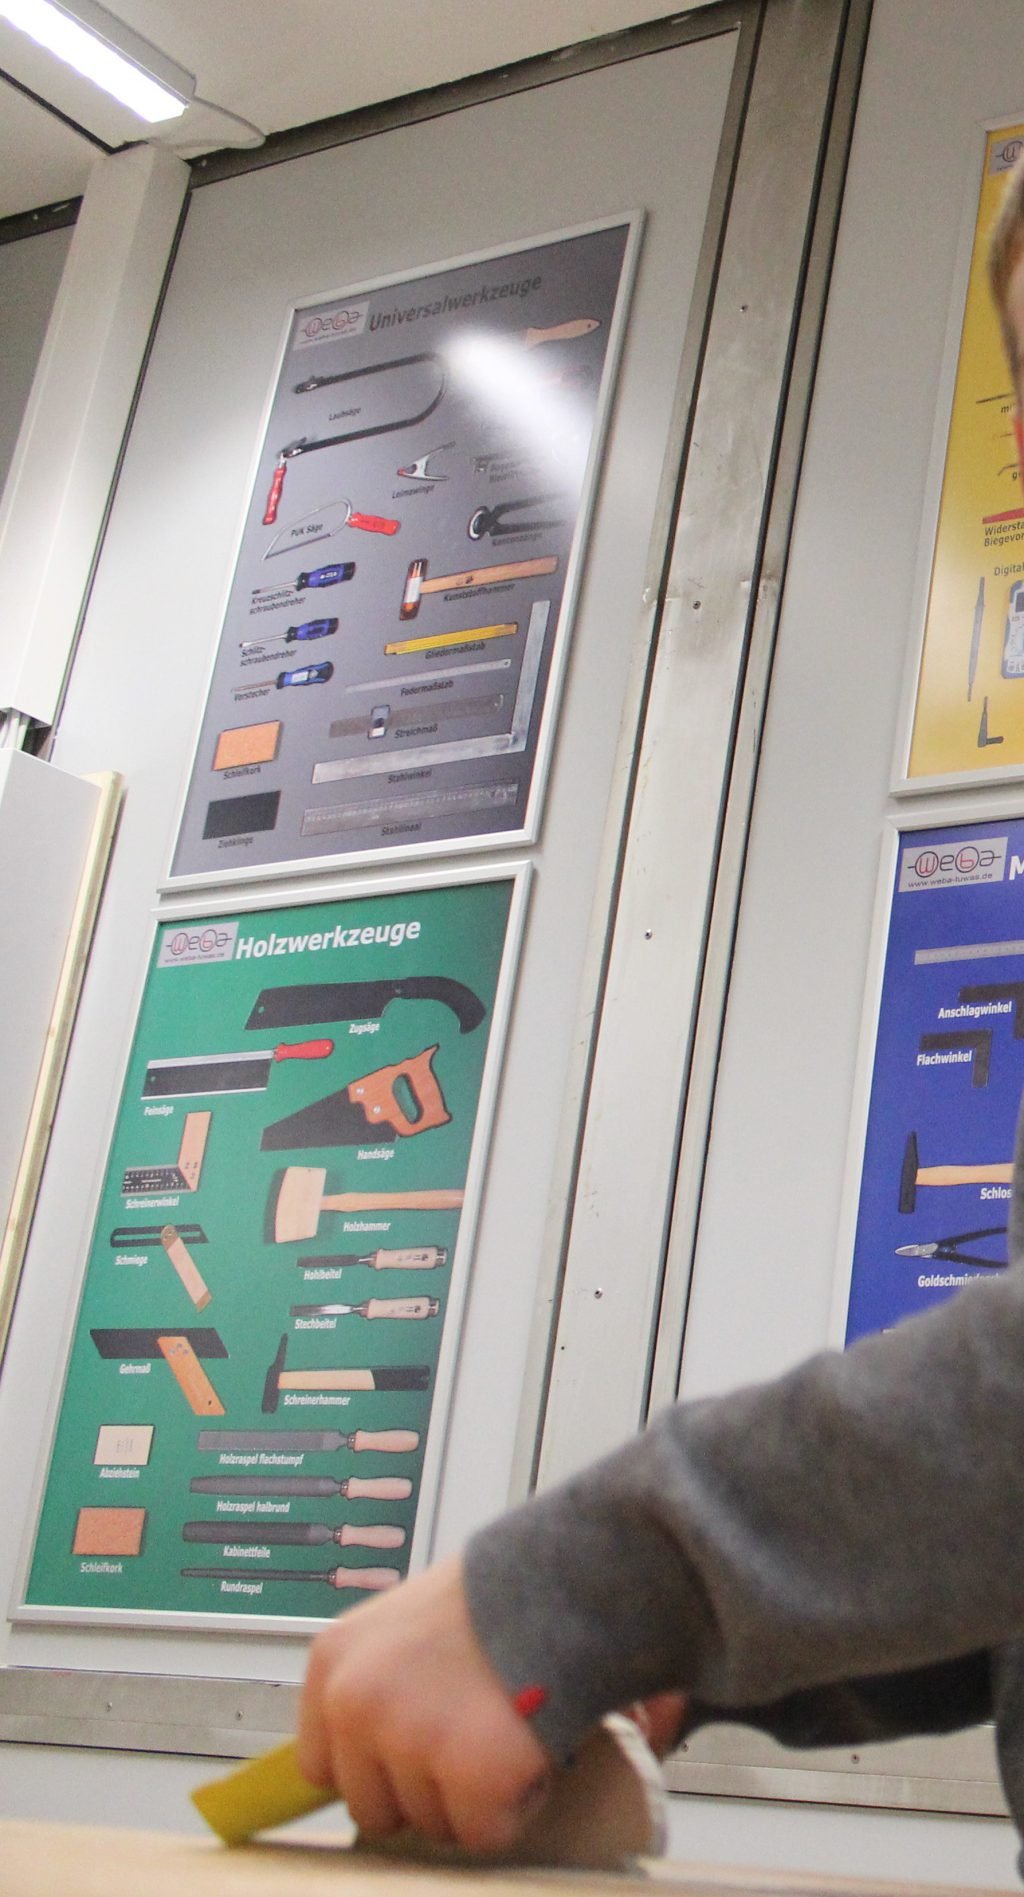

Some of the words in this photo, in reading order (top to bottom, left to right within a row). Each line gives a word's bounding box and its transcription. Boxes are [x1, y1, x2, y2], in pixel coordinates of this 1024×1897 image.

[369, 275, 542, 332] Universalwerkzeuge
[240, 650, 297, 667] schraubendreher
[394, 724, 438, 739] Streichmaß
[236, 921, 421, 960] Holzwerkzeuge
[938, 1001, 1012, 1019] Anschlagwinkel
[349, 1022, 380, 1035] Zugsäge
[916, 1050, 972, 1066] Flachwinkel
[144, 1105, 174, 1116] Feinsäge
[357, 1148, 395, 1160] Handsäge
[980, 1187, 1012, 1200] Schlos
[126, 1196, 180, 1209] Schreinerwinkel
[343, 1221, 391, 1232] Holzhammer
[115, 1254, 148, 1267] Schmiege
[304, 1268, 342, 1280] Hohlbeitel
[294, 1318, 337, 1329] Stechbeitel
[119, 1363, 151, 1374] Gehrmaß
[284, 1394, 351, 1406] Schreinerhammer
[219, 1453, 258, 1466] Holzraspel
[99, 1467, 140, 1479] Abziehstein
[216, 1500, 255, 1512] Holzraspel
[256, 1502, 290, 1513] halbrund
[223, 1545, 271, 1558] Kabinettfeile
[80, 1562, 122, 1573] Schleifkork
[220, 1581, 263, 1594] Rundraspel
